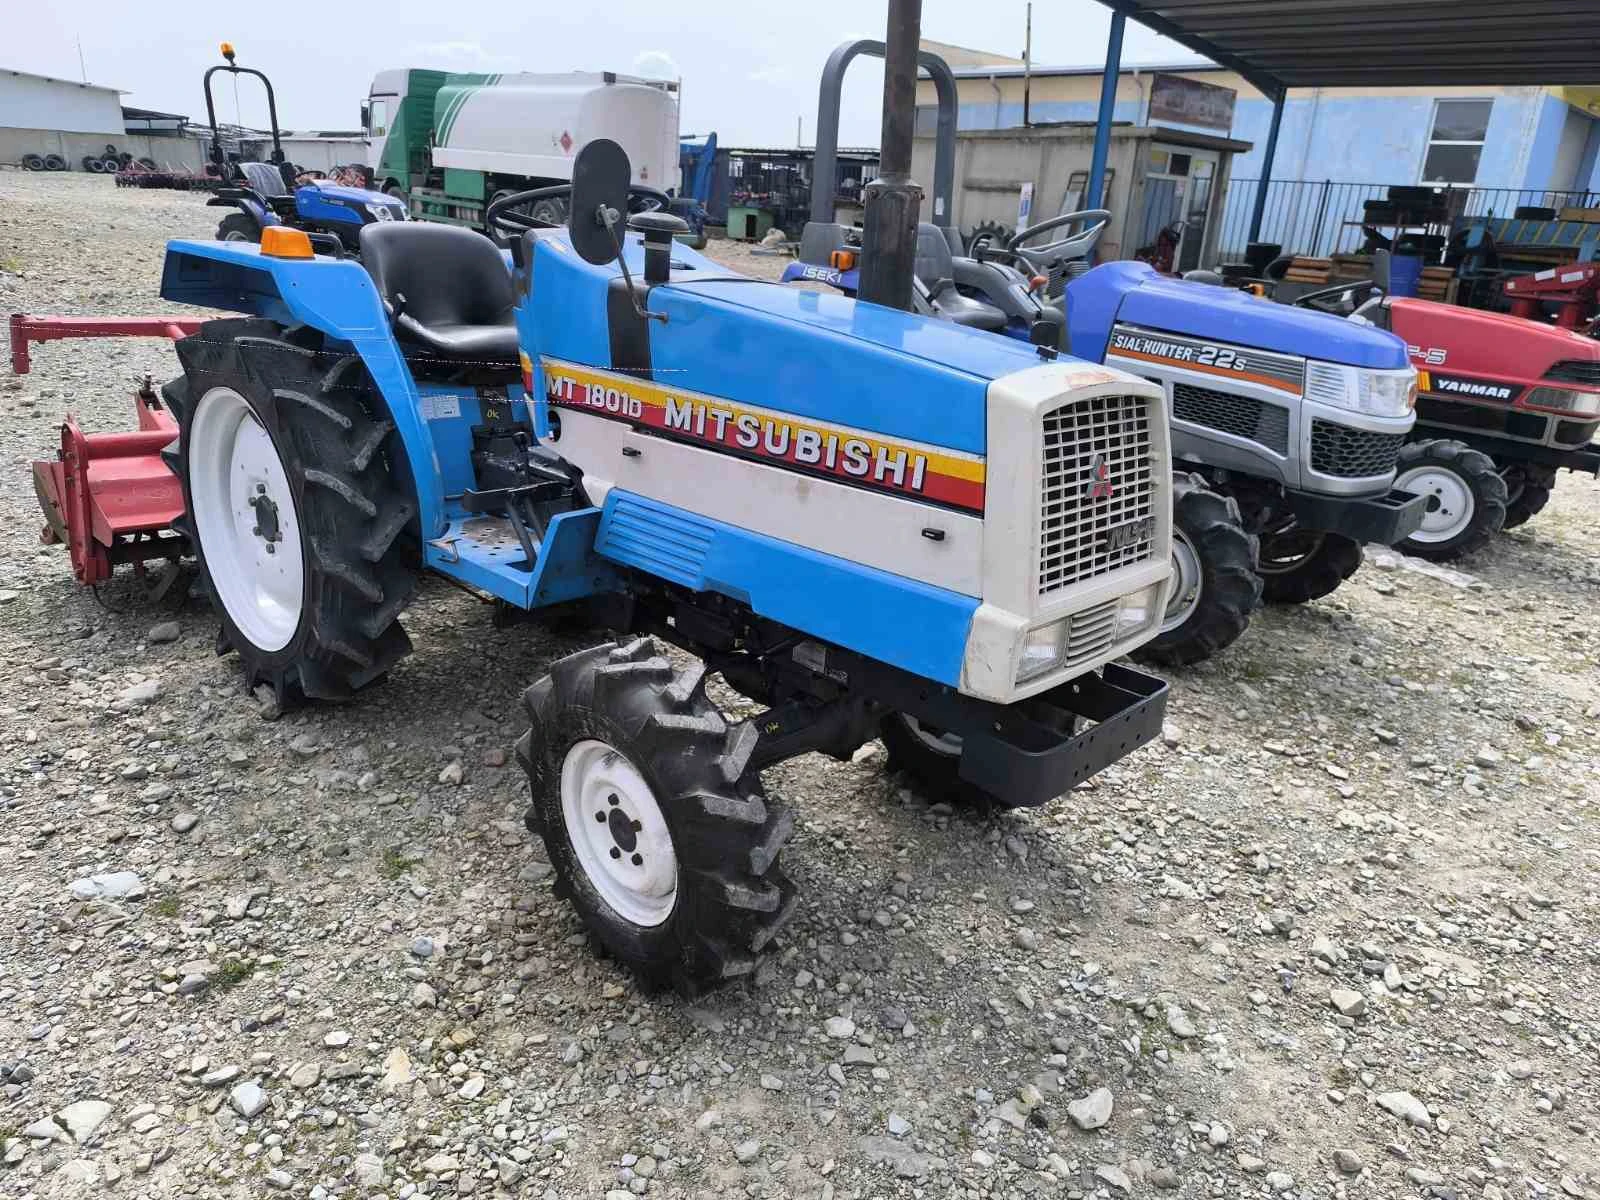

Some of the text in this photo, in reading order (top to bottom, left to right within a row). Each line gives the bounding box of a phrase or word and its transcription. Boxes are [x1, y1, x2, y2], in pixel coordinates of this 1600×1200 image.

[802, 265, 842, 283] ISEKI
[1142, 339, 1193, 361] HUNTER
[546, 373, 576, 399] MT
[1438, 379, 1511, 398] YANMAR
[664, 397, 926, 491] MITSUBISHI
